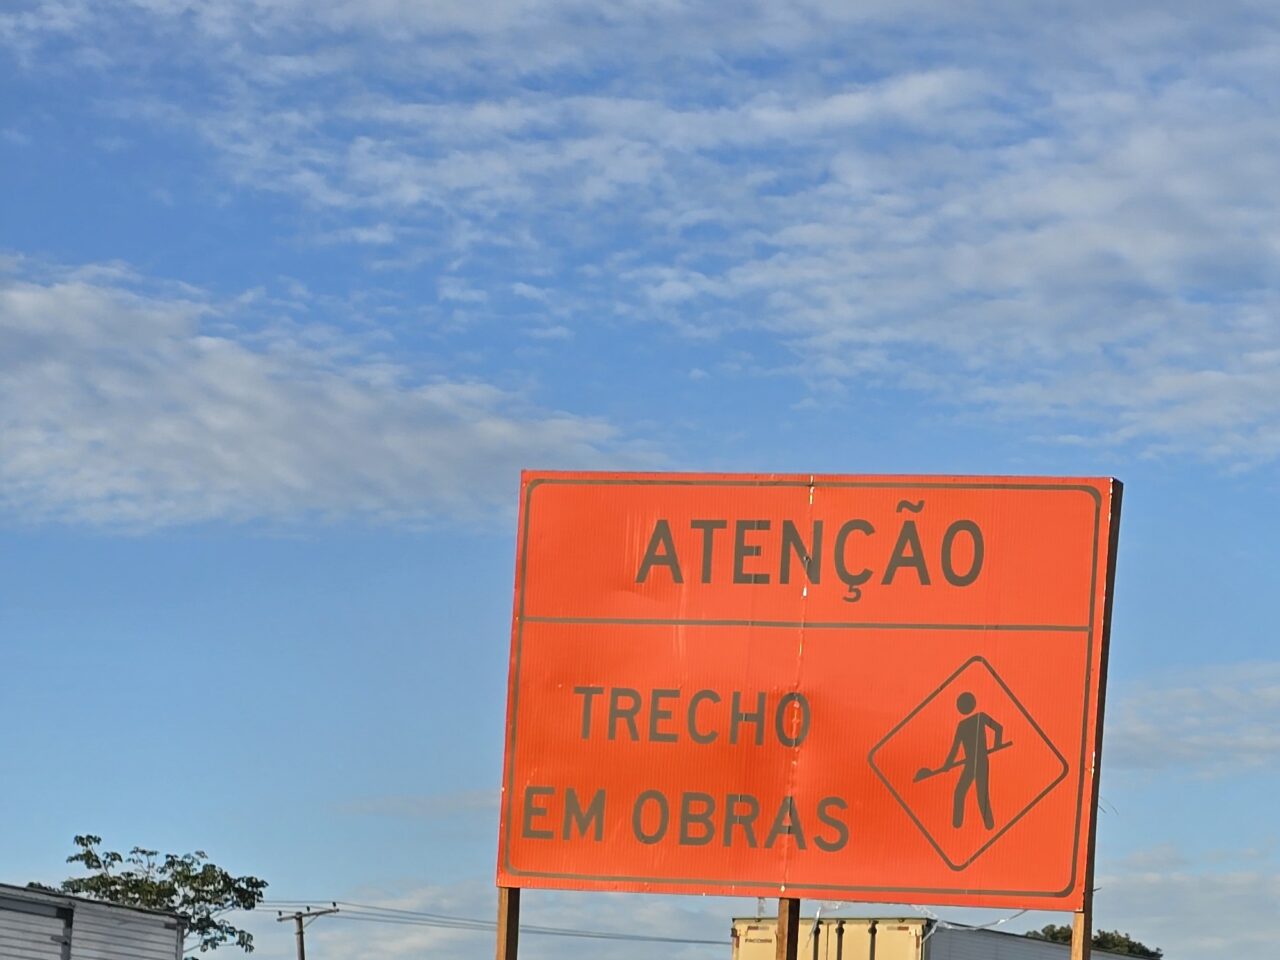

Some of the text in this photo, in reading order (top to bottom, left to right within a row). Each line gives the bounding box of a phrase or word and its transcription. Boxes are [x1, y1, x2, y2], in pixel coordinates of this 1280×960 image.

[635, 500, 985, 603] ATENÇÃO
[574, 686, 812, 748] TRECHO
[522, 786, 849, 852] EM OBRAS
